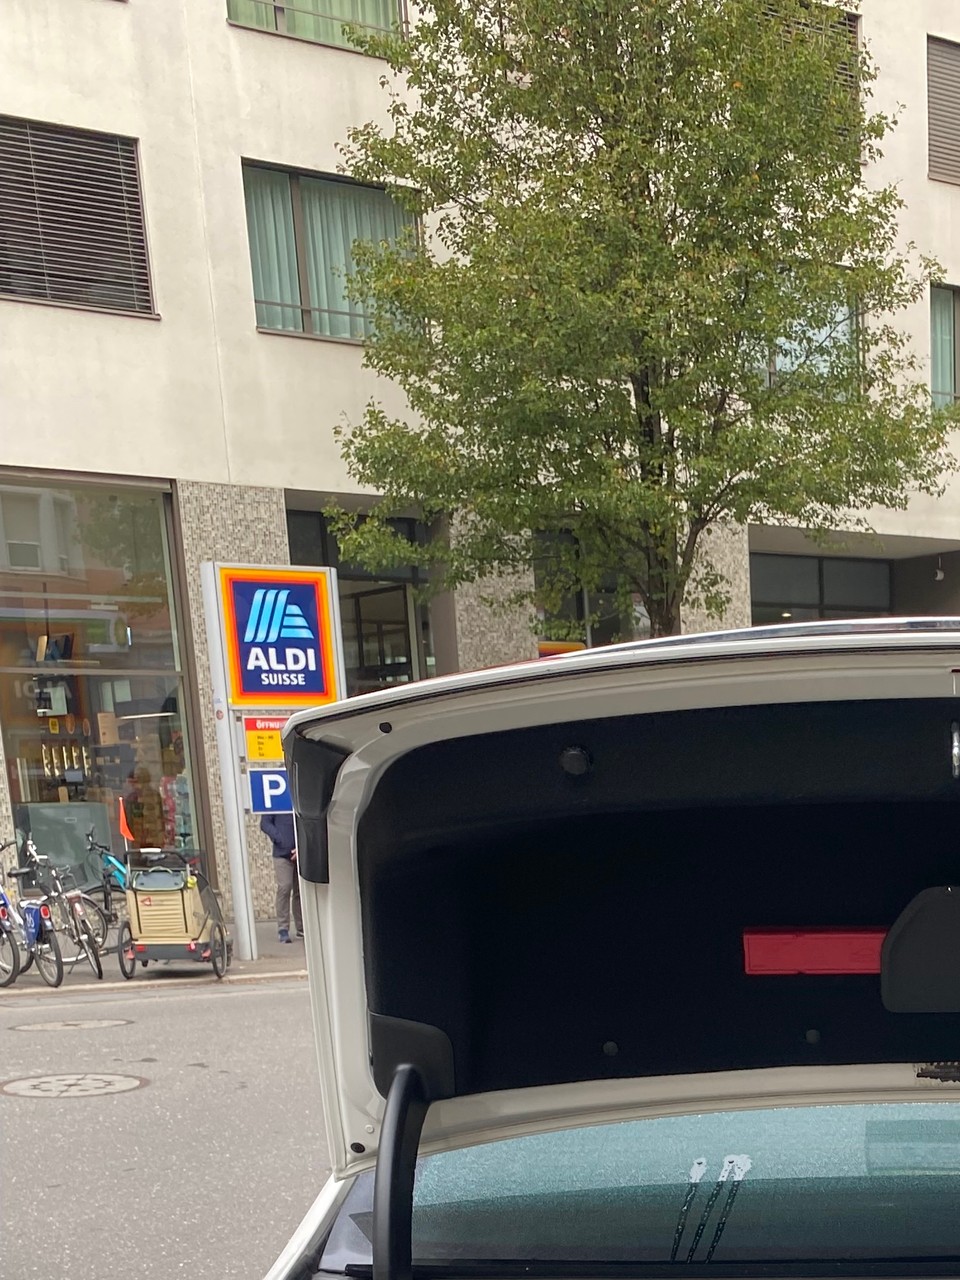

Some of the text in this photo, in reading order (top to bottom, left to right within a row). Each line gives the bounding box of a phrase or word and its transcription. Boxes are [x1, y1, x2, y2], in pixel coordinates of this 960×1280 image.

[247, 647, 316, 671] ALDI
[261, 673, 306, 685] SUISSE
[262, 774, 287, 809] P
